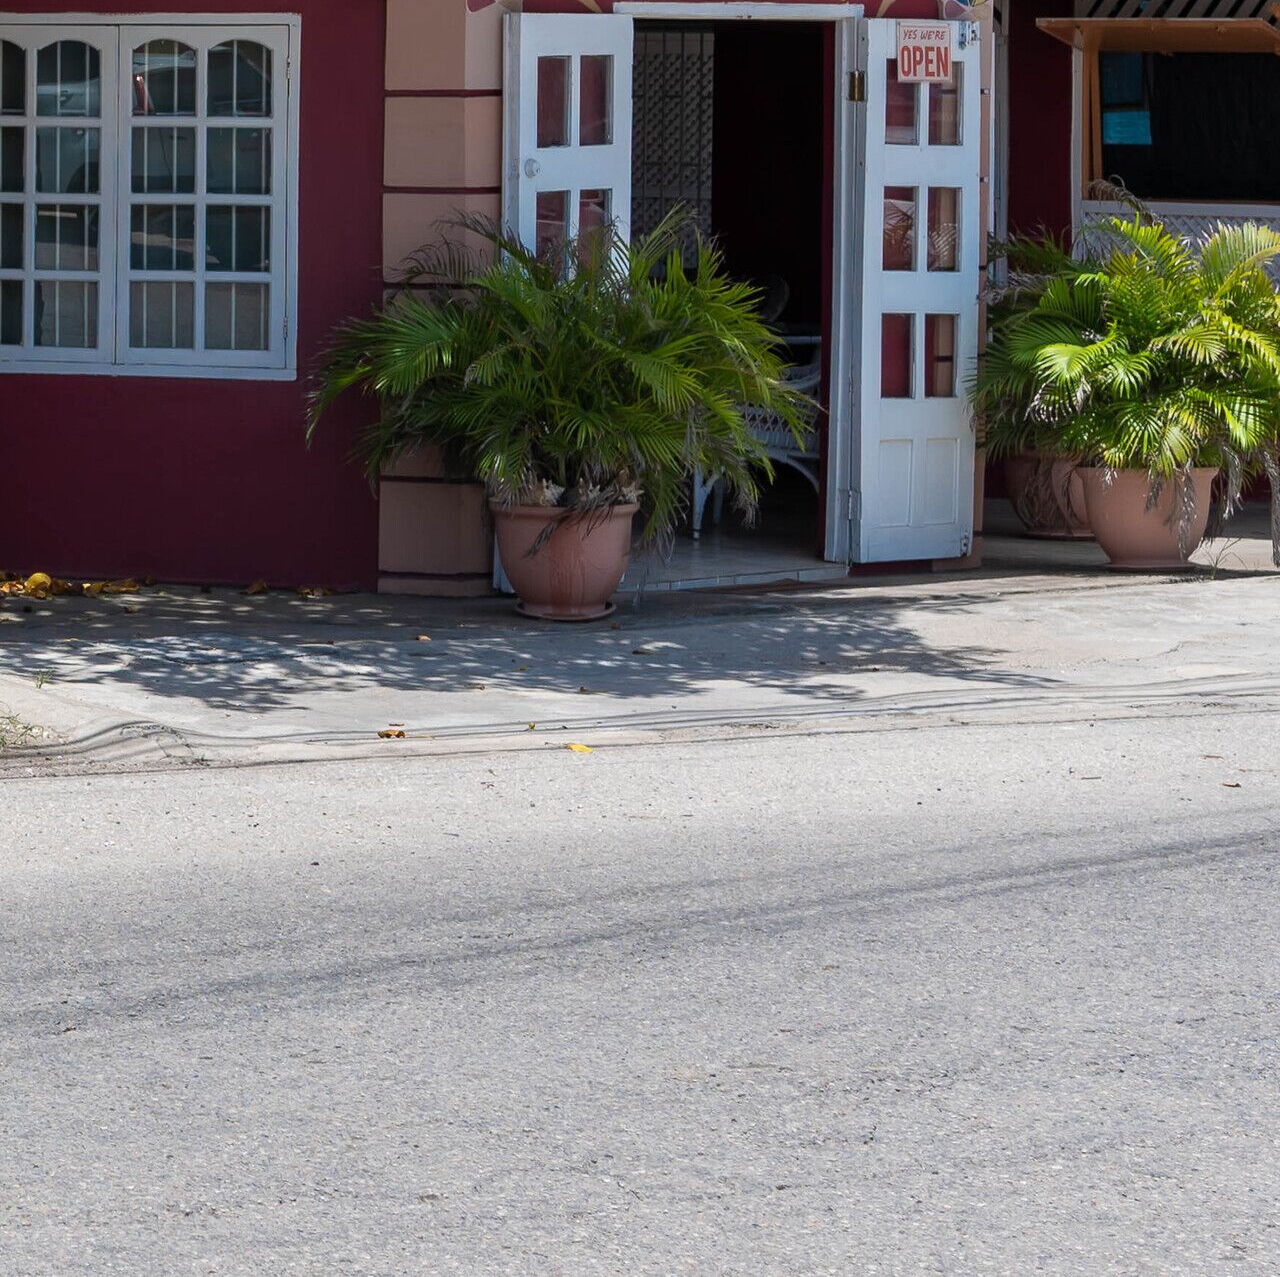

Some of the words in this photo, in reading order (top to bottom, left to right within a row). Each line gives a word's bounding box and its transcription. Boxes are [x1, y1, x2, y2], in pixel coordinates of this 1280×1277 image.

[903, 29, 918, 40] YES
[920, 30, 946, 41] WE'RE
[901, 45, 949, 77] OPEN
